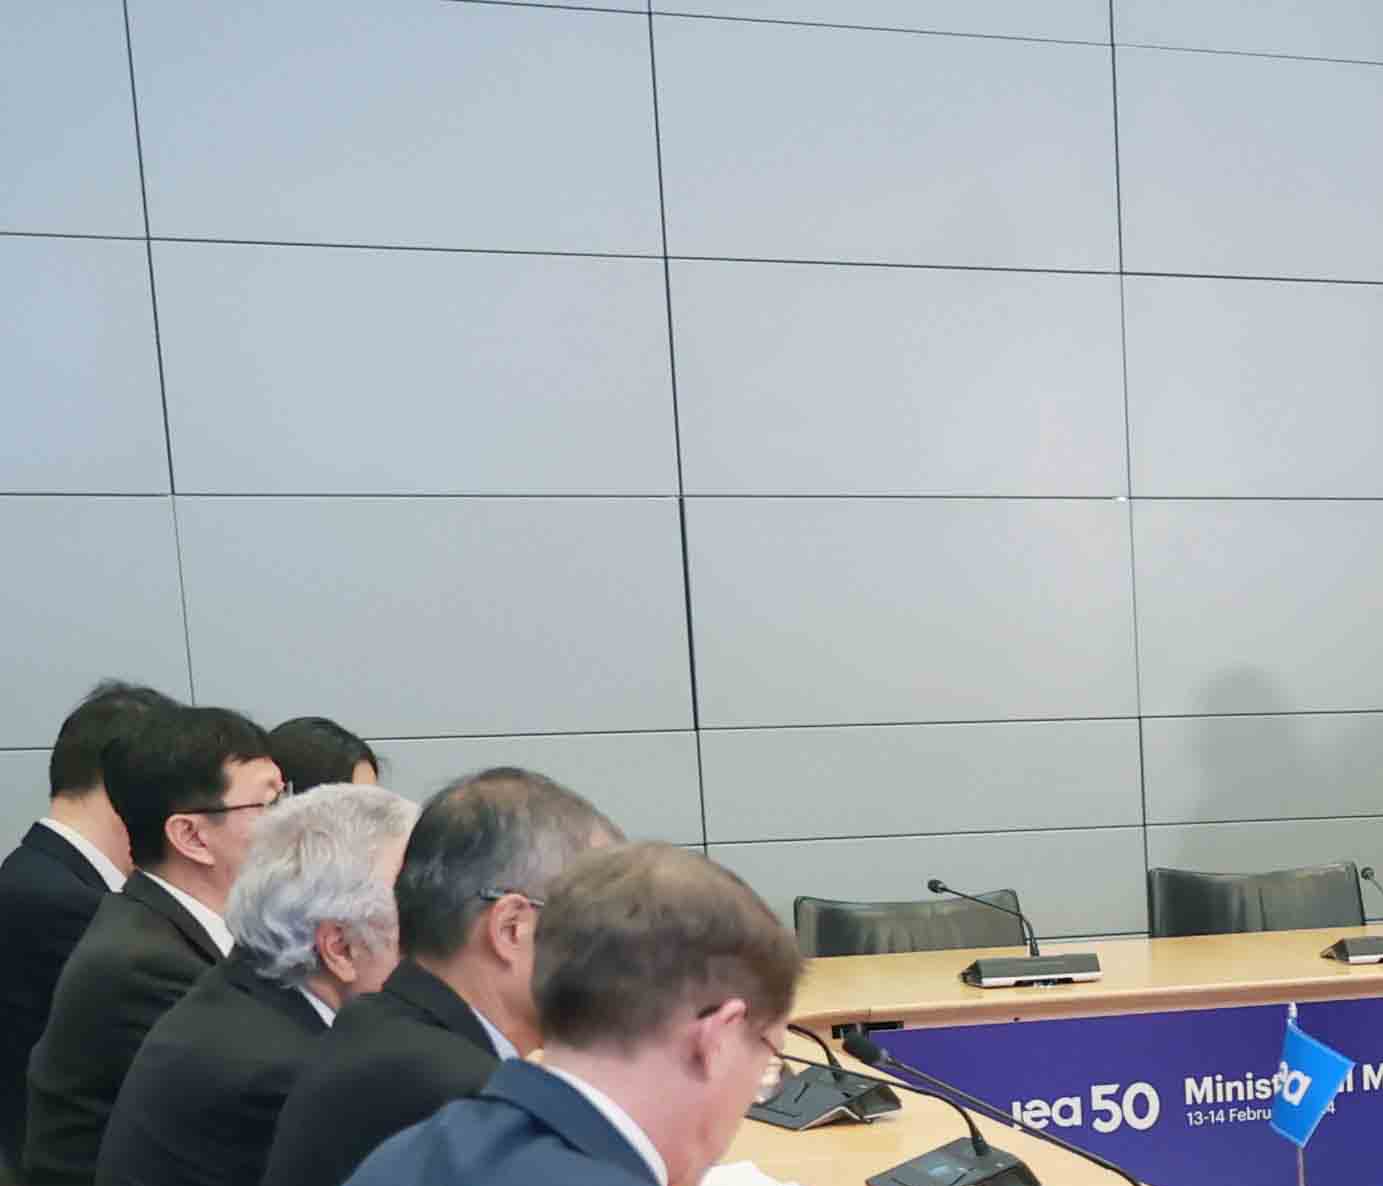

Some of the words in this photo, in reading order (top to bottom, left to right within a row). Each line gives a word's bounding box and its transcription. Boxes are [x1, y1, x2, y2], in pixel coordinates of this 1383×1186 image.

[1184, 1067, 1355, 1106] Ministl
[1090, 1081, 1161, 1134] 50
[1186, 1109, 1225, 1126] 13-14
[1228, 1107, 1272, 1123] Febru
